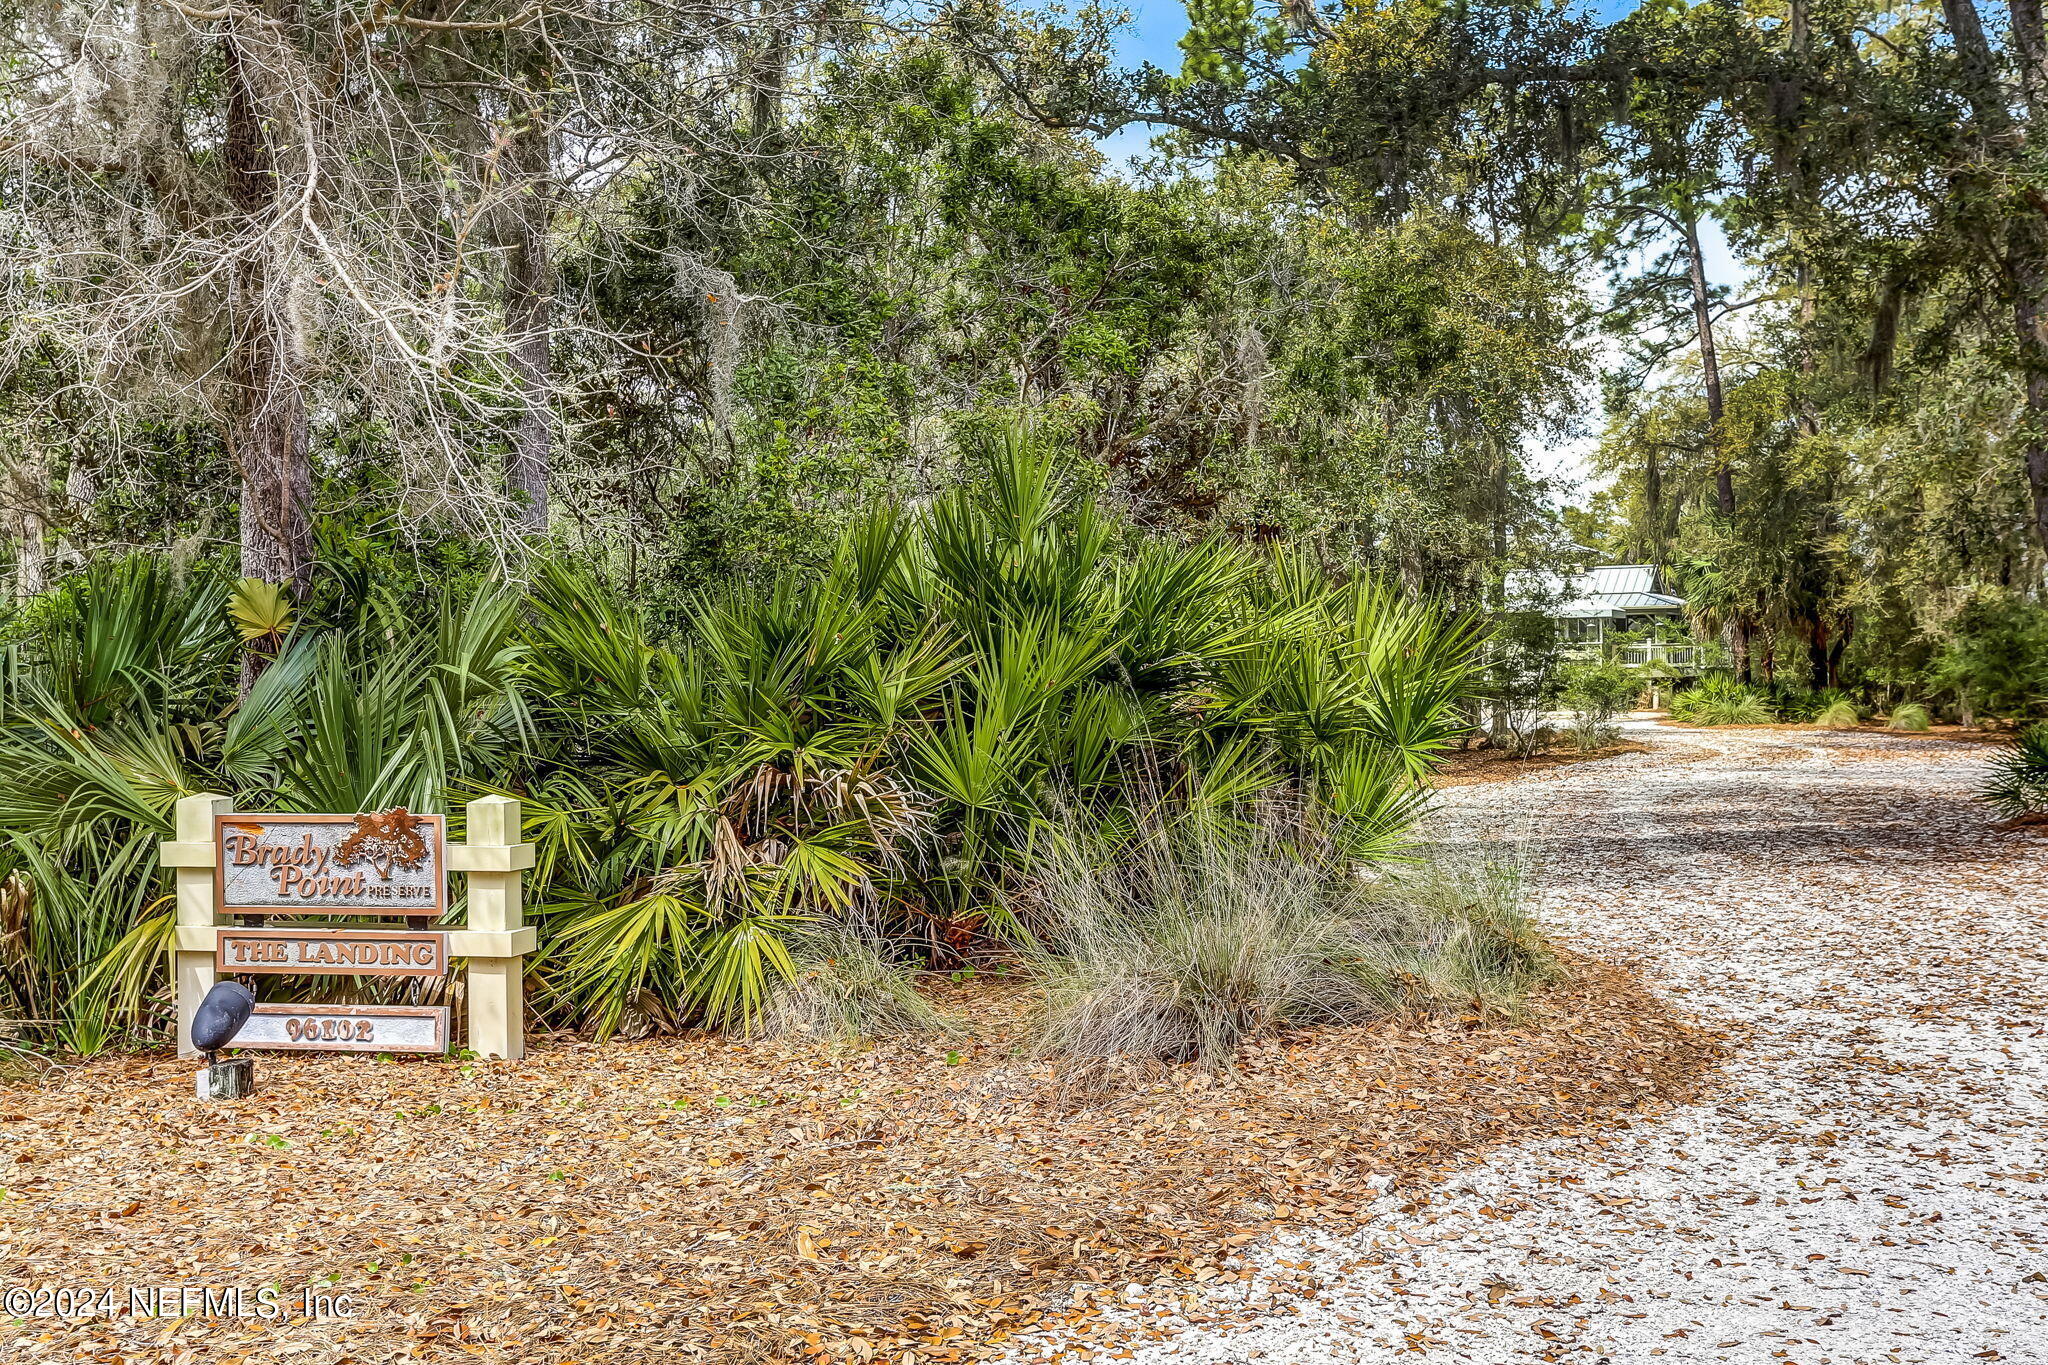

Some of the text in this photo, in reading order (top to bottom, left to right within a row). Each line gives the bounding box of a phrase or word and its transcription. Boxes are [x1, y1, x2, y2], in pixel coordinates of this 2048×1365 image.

[226, 834, 330, 874] Brady
[270, 864, 430, 898] Point PRESERVE
[232, 941, 433, 965] THE LANDING
